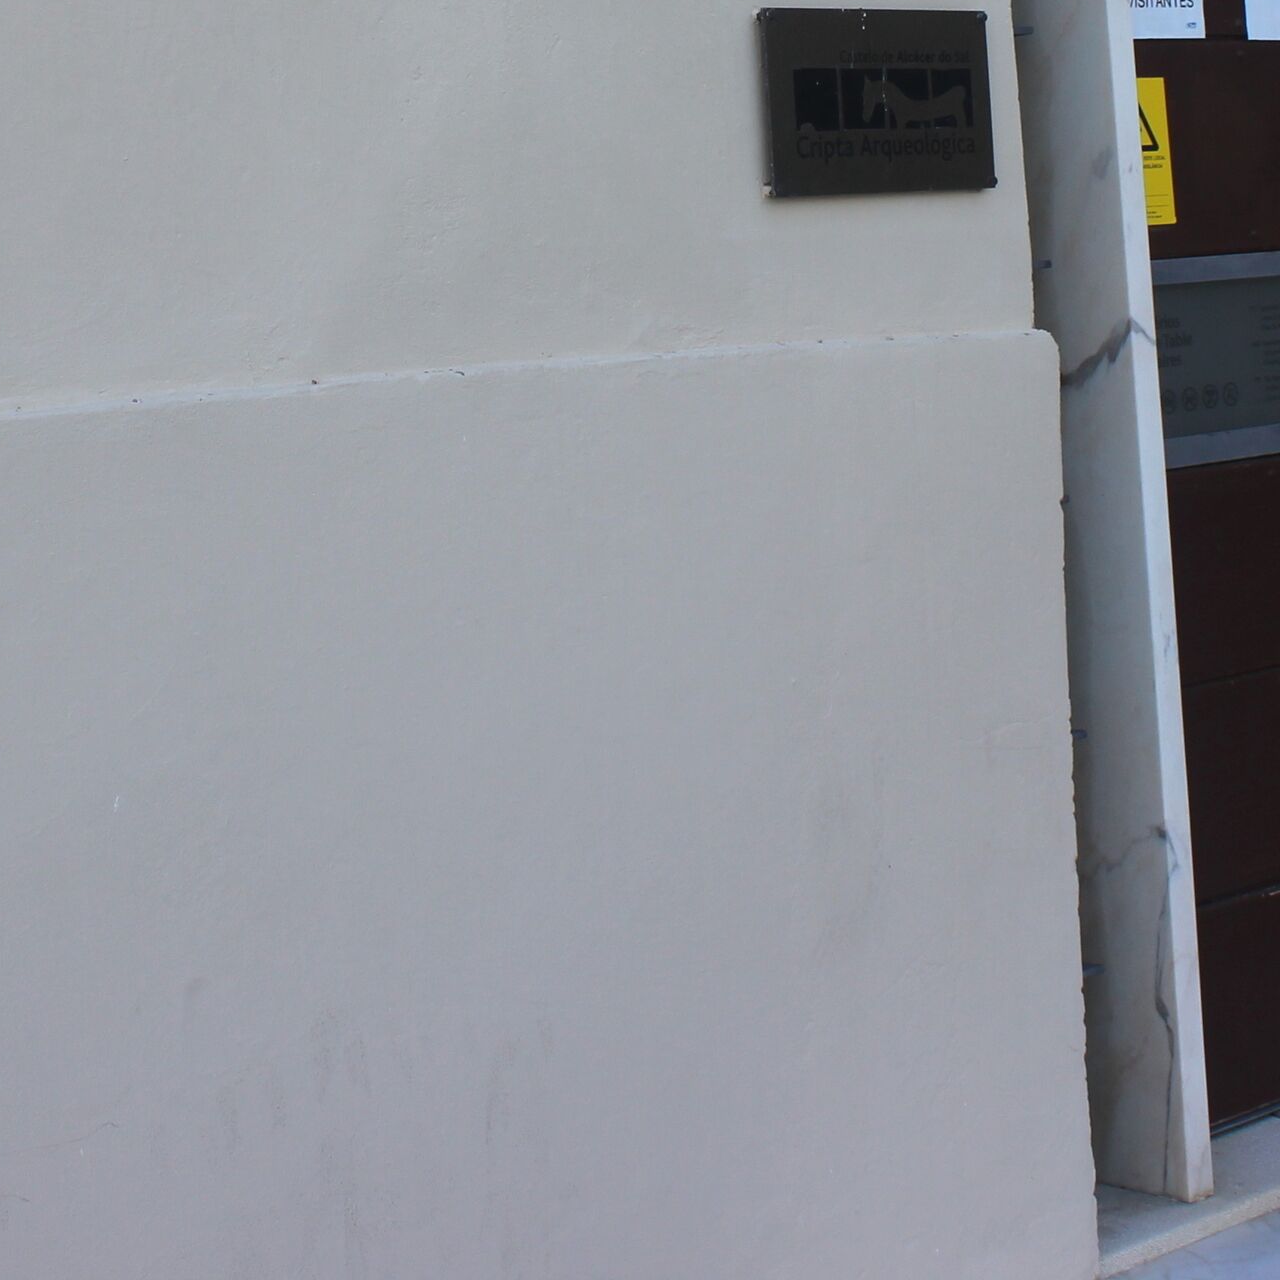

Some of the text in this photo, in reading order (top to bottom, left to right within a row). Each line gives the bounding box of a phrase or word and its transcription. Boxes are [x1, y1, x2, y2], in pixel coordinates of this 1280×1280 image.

[938, 50, 952, 63] do
[796, 132, 976, 165] Cripta Arqueológica
